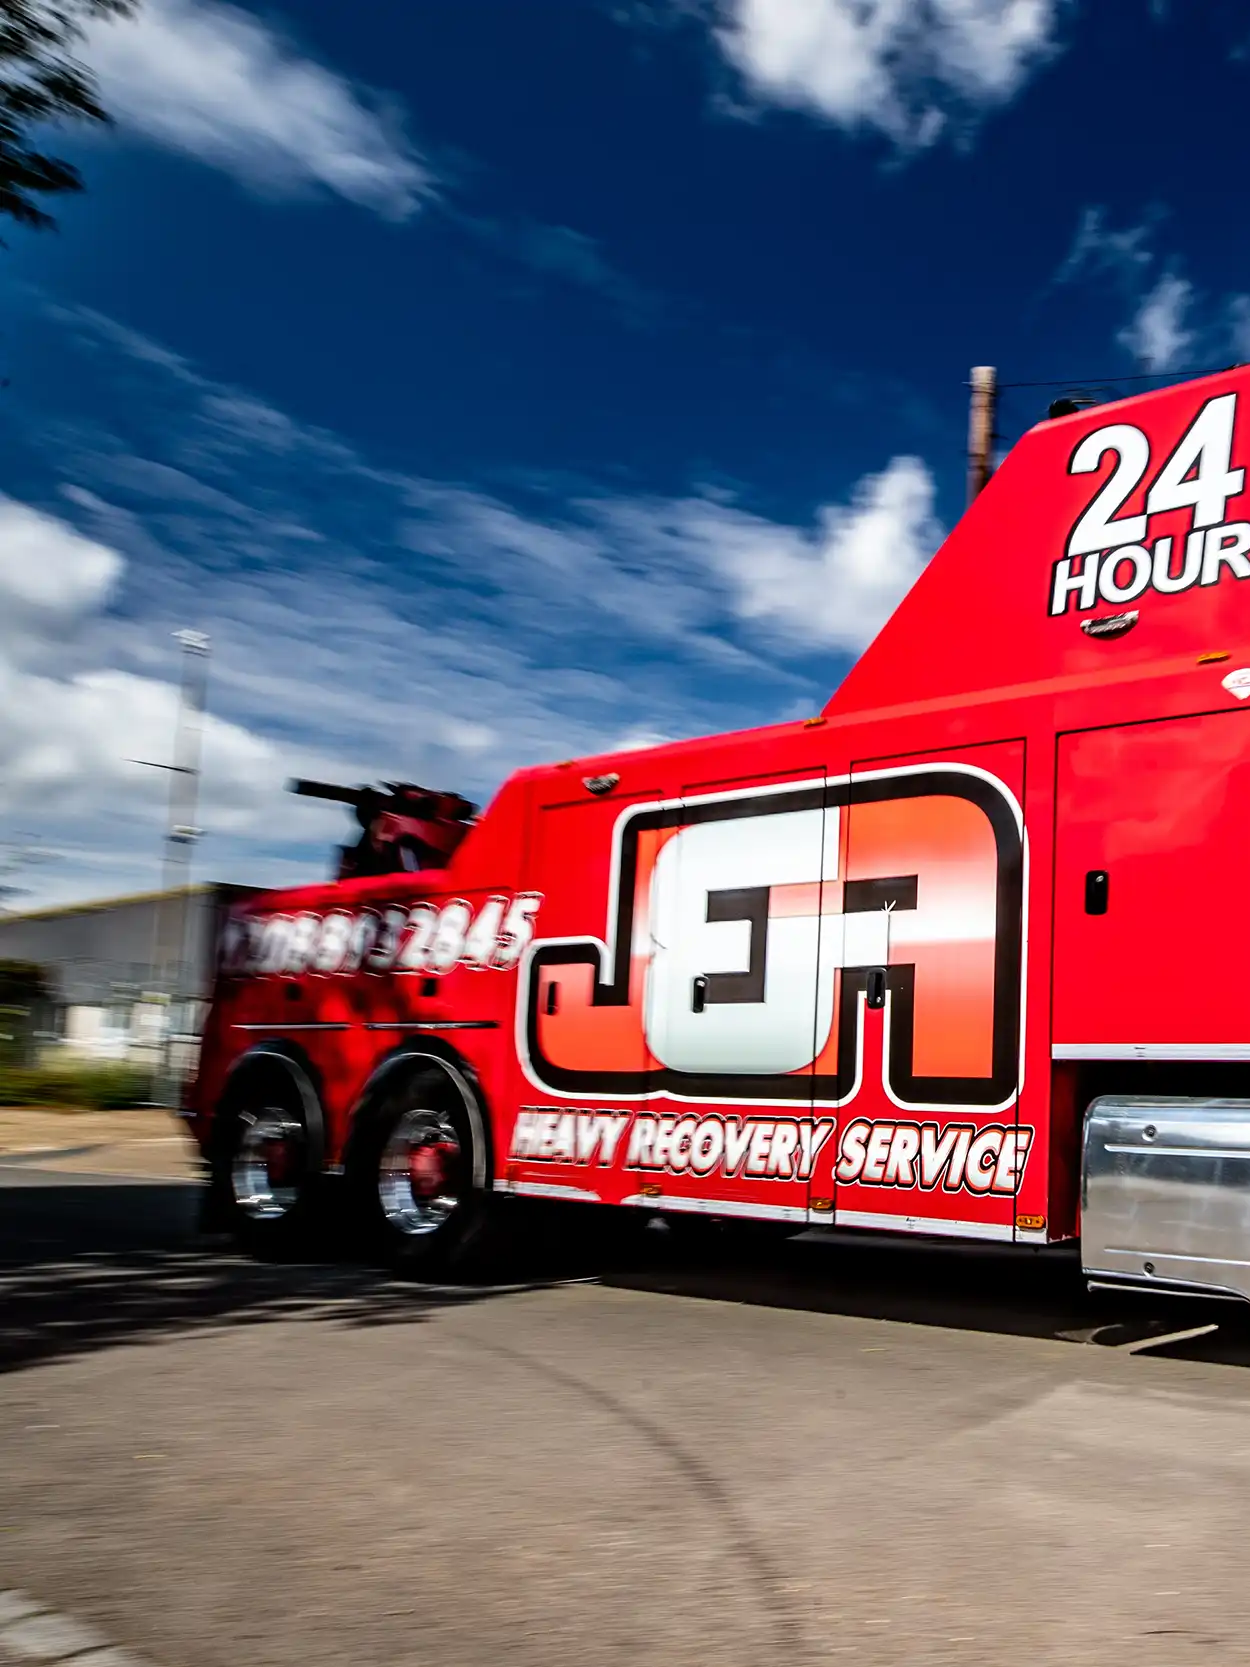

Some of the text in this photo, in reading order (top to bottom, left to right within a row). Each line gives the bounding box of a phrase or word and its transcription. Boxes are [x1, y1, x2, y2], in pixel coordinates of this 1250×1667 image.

[1067, 392, 1245, 558] 24
[507, 1106, 1034, 1198] HEAVY RECOVERY SERVICE
